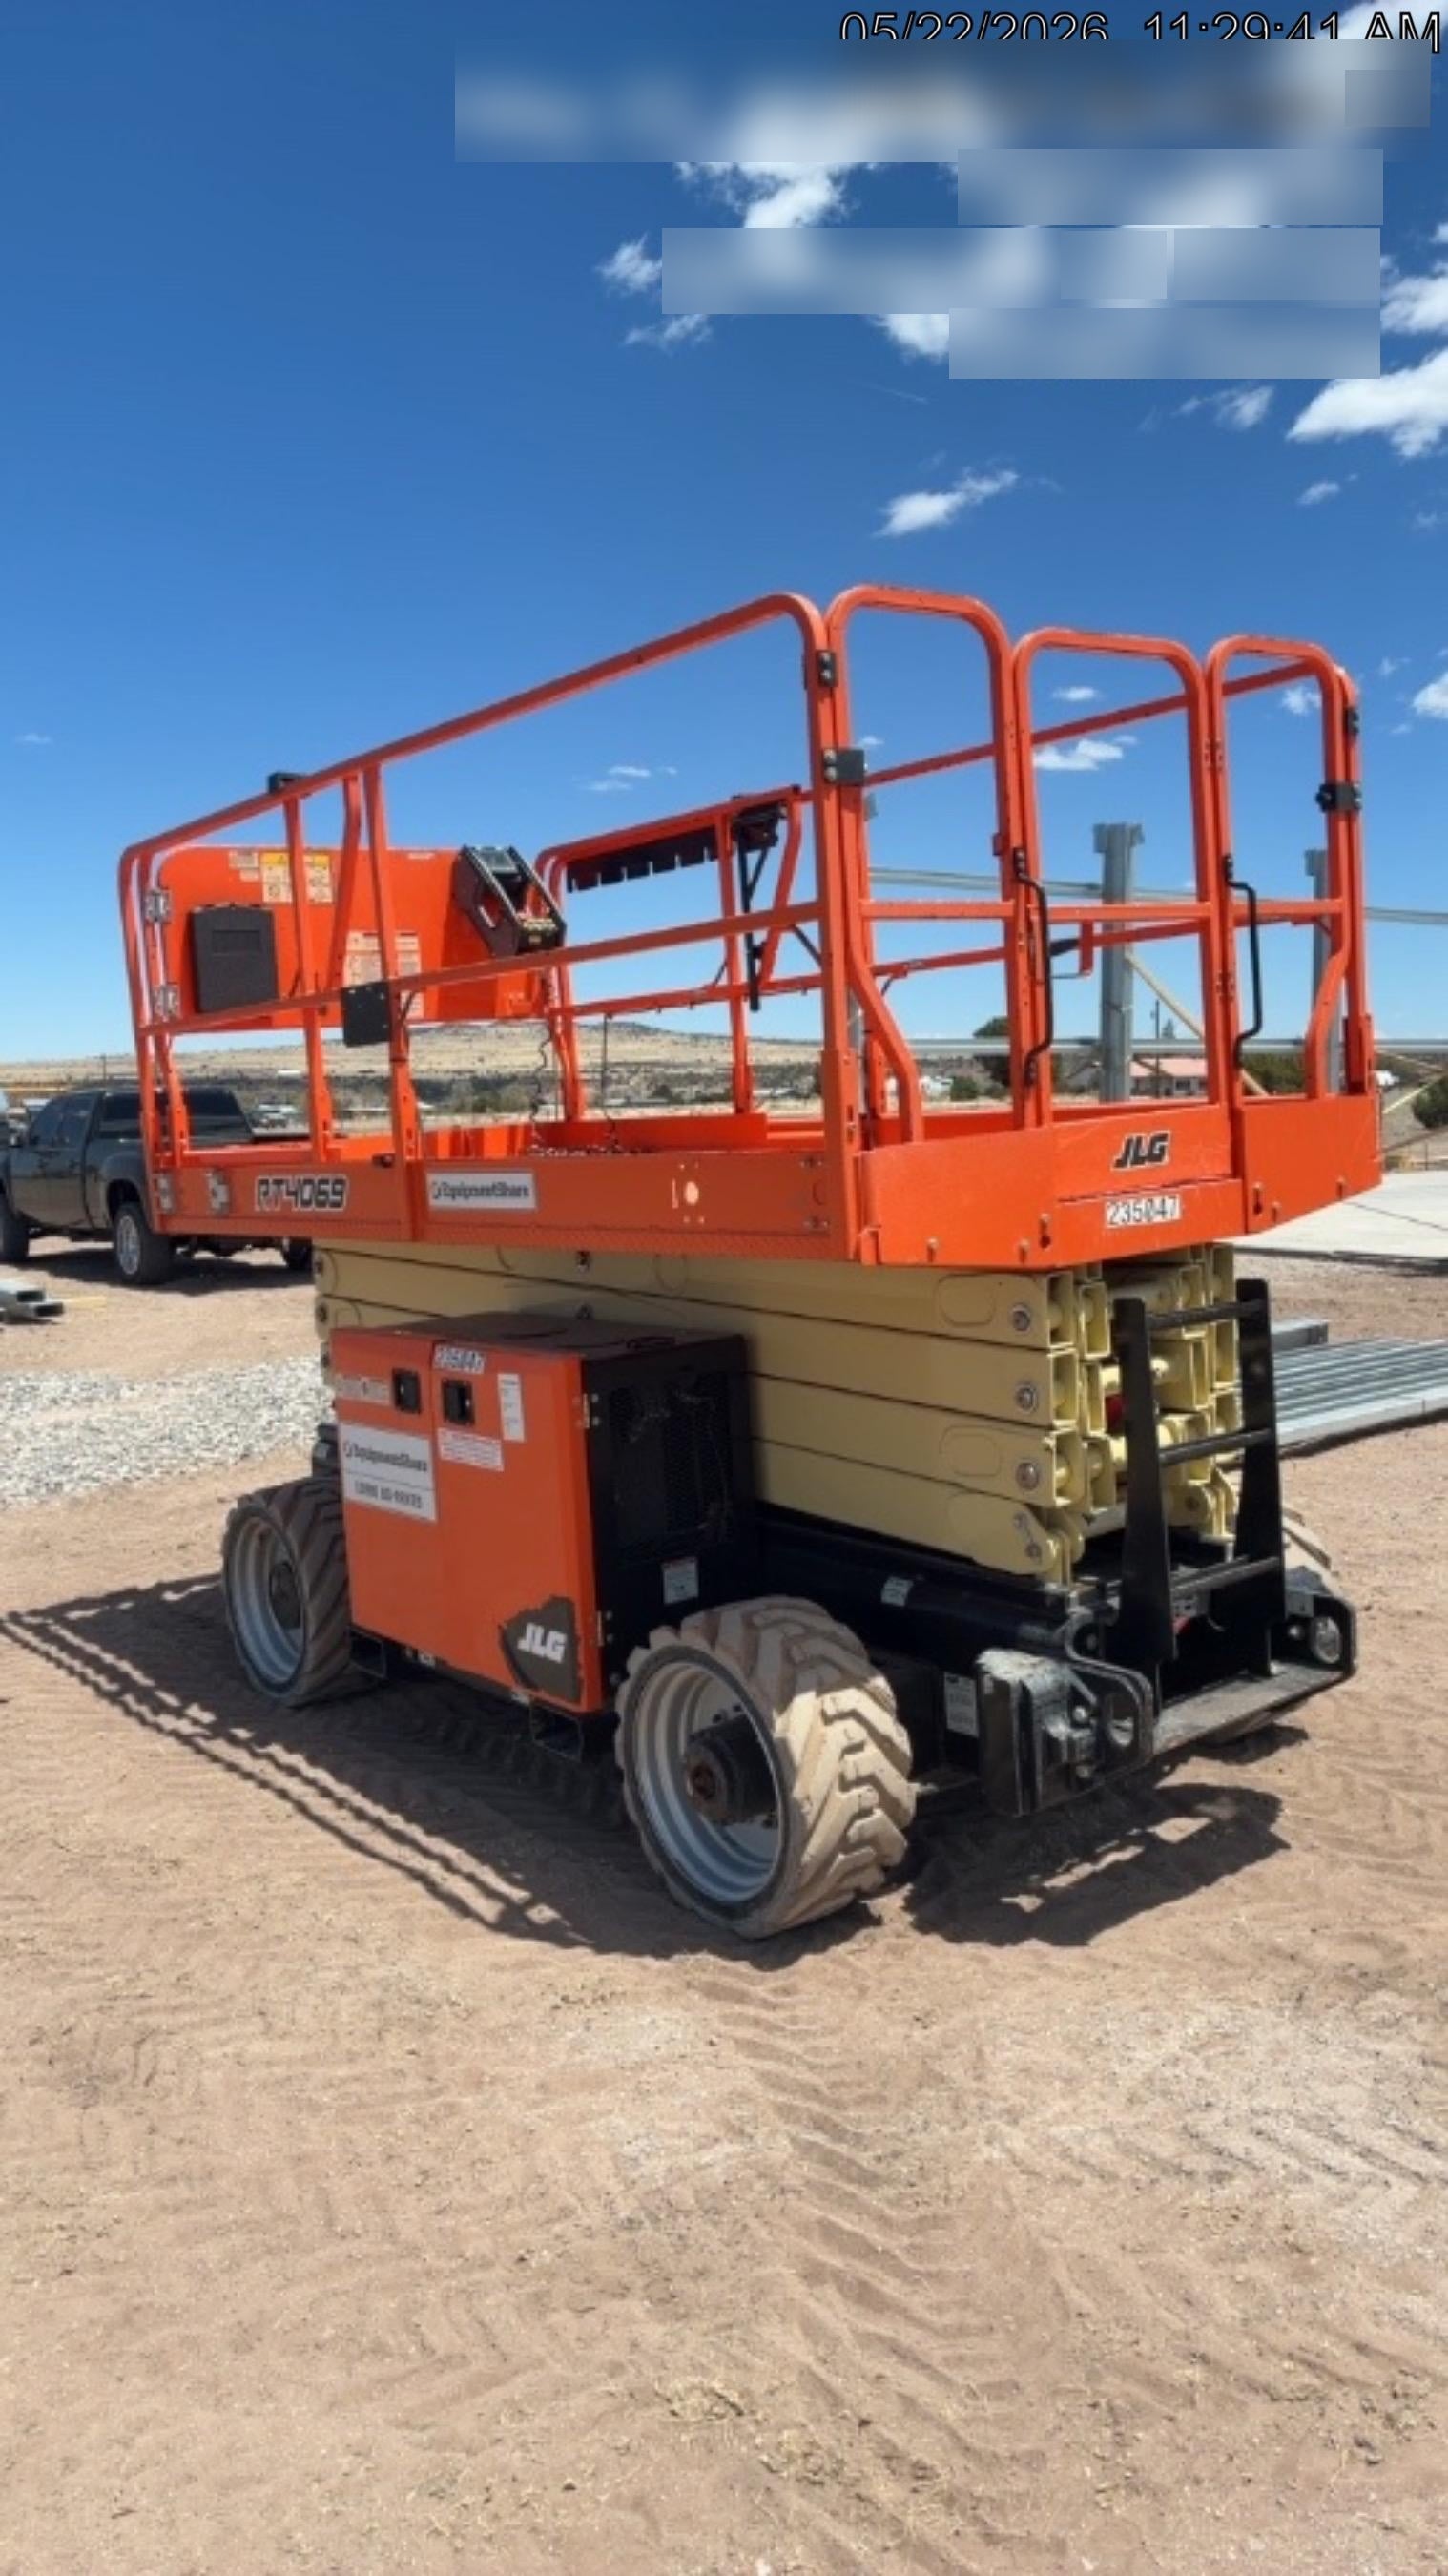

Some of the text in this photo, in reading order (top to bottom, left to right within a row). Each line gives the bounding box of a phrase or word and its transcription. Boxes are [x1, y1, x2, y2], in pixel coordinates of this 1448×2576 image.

[1110, 1132, 1169, 1170] JLG
[256, 1175, 347, 1211] RT4069
[1107, 1196, 1178, 1225] 235047
[517, 1622, 567, 1663] JLG
